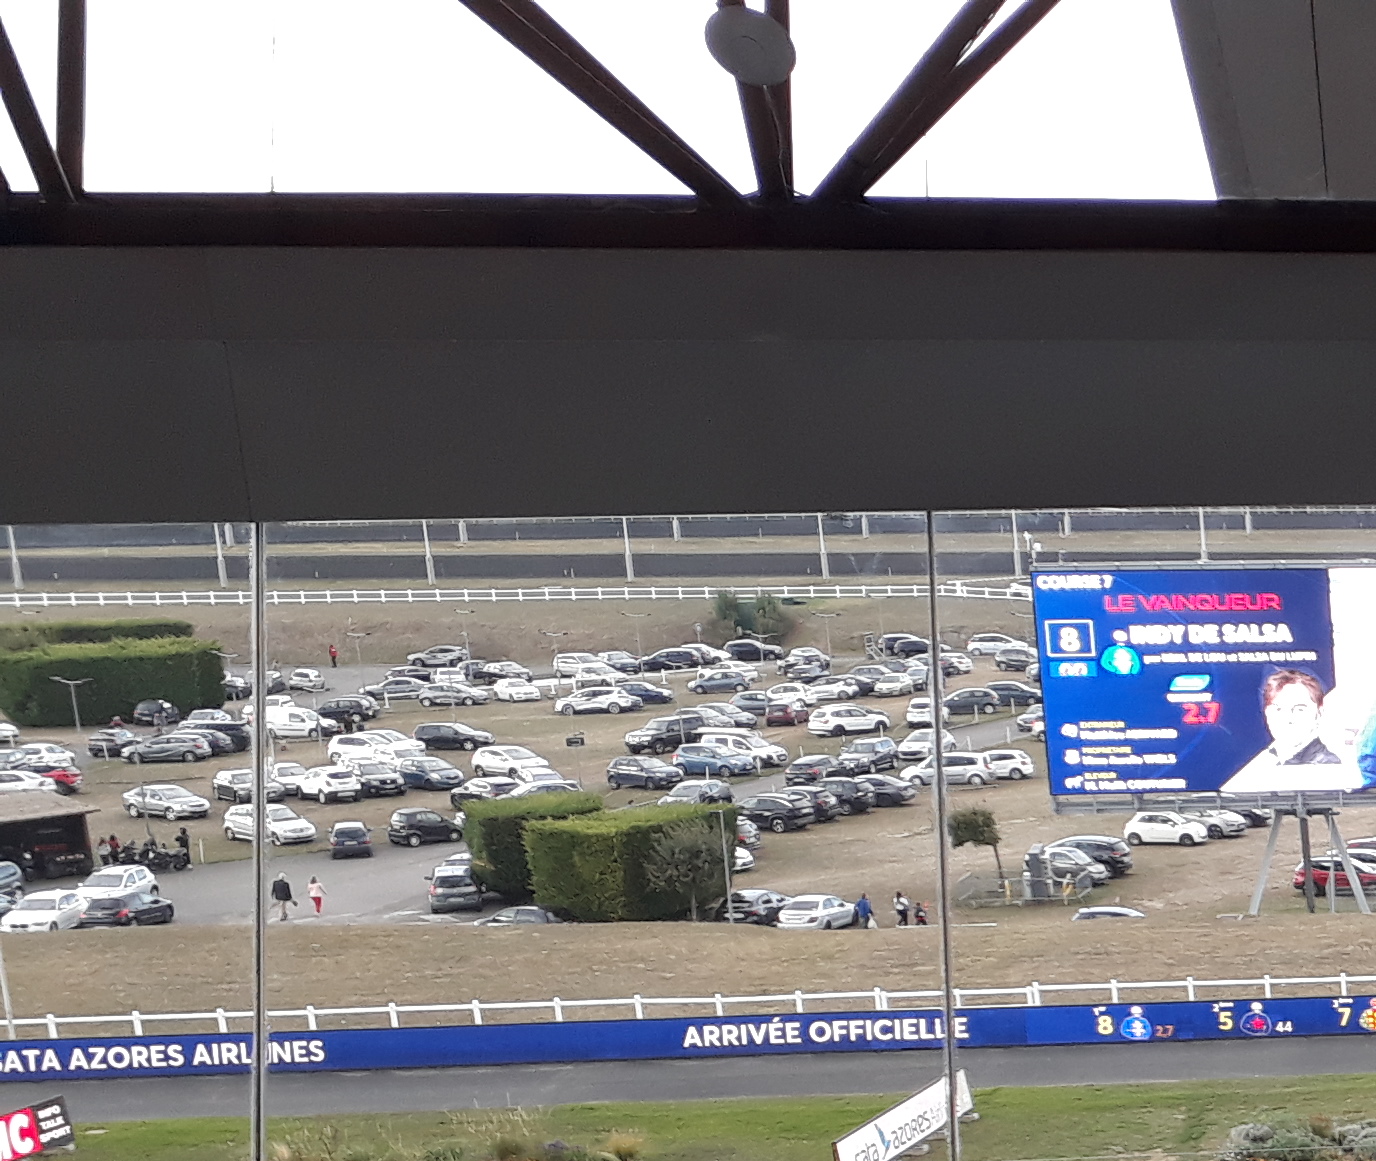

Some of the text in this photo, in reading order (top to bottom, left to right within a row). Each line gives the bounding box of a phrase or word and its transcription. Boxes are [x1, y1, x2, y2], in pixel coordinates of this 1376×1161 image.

[1105, 594, 1281, 612] LE VAINQUEUR
[1060, 627, 1080, 651] 8
[1130, 624, 1293, 644] INDY DE SALSA
[683, 1017, 969, 1048] ARRIVÉE OFFICIELLE
[1097, 1015, 1114, 1035] 8
[1219, 1012, 1233, 1030] 5
[1275, 1021, 1293, 1032] 44
[1338, 1007, 1352, 1027] 7
[69, 1045, 184, 1070] AZORES
[892, 1111, 932, 1149] azores
